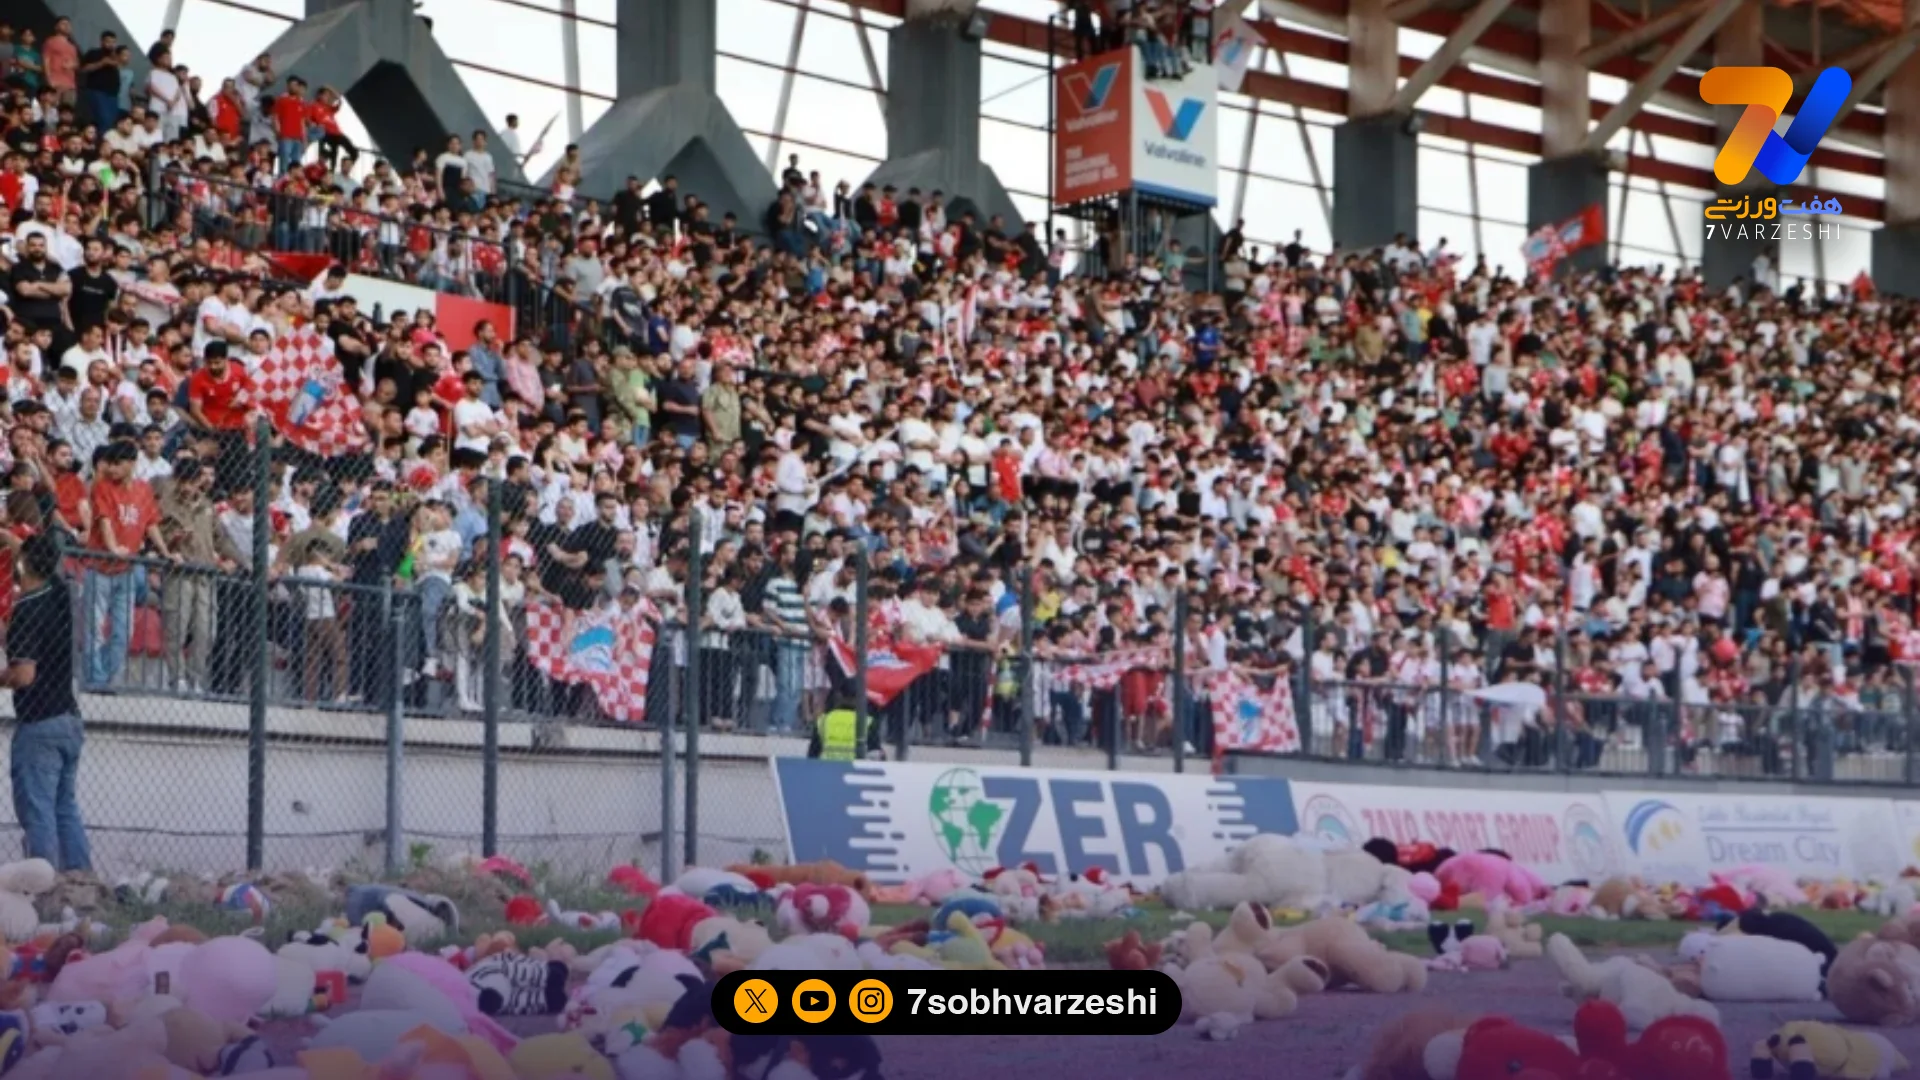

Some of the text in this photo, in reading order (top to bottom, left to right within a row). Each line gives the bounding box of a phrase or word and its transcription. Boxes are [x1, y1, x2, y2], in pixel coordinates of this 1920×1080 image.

[1144, 140, 1207, 168] Valvoline
[980, 776, 1186, 876] ZER
[1494, 812, 1562, 863] GROUP
[1705, 835, 1841, 866] Dream City
